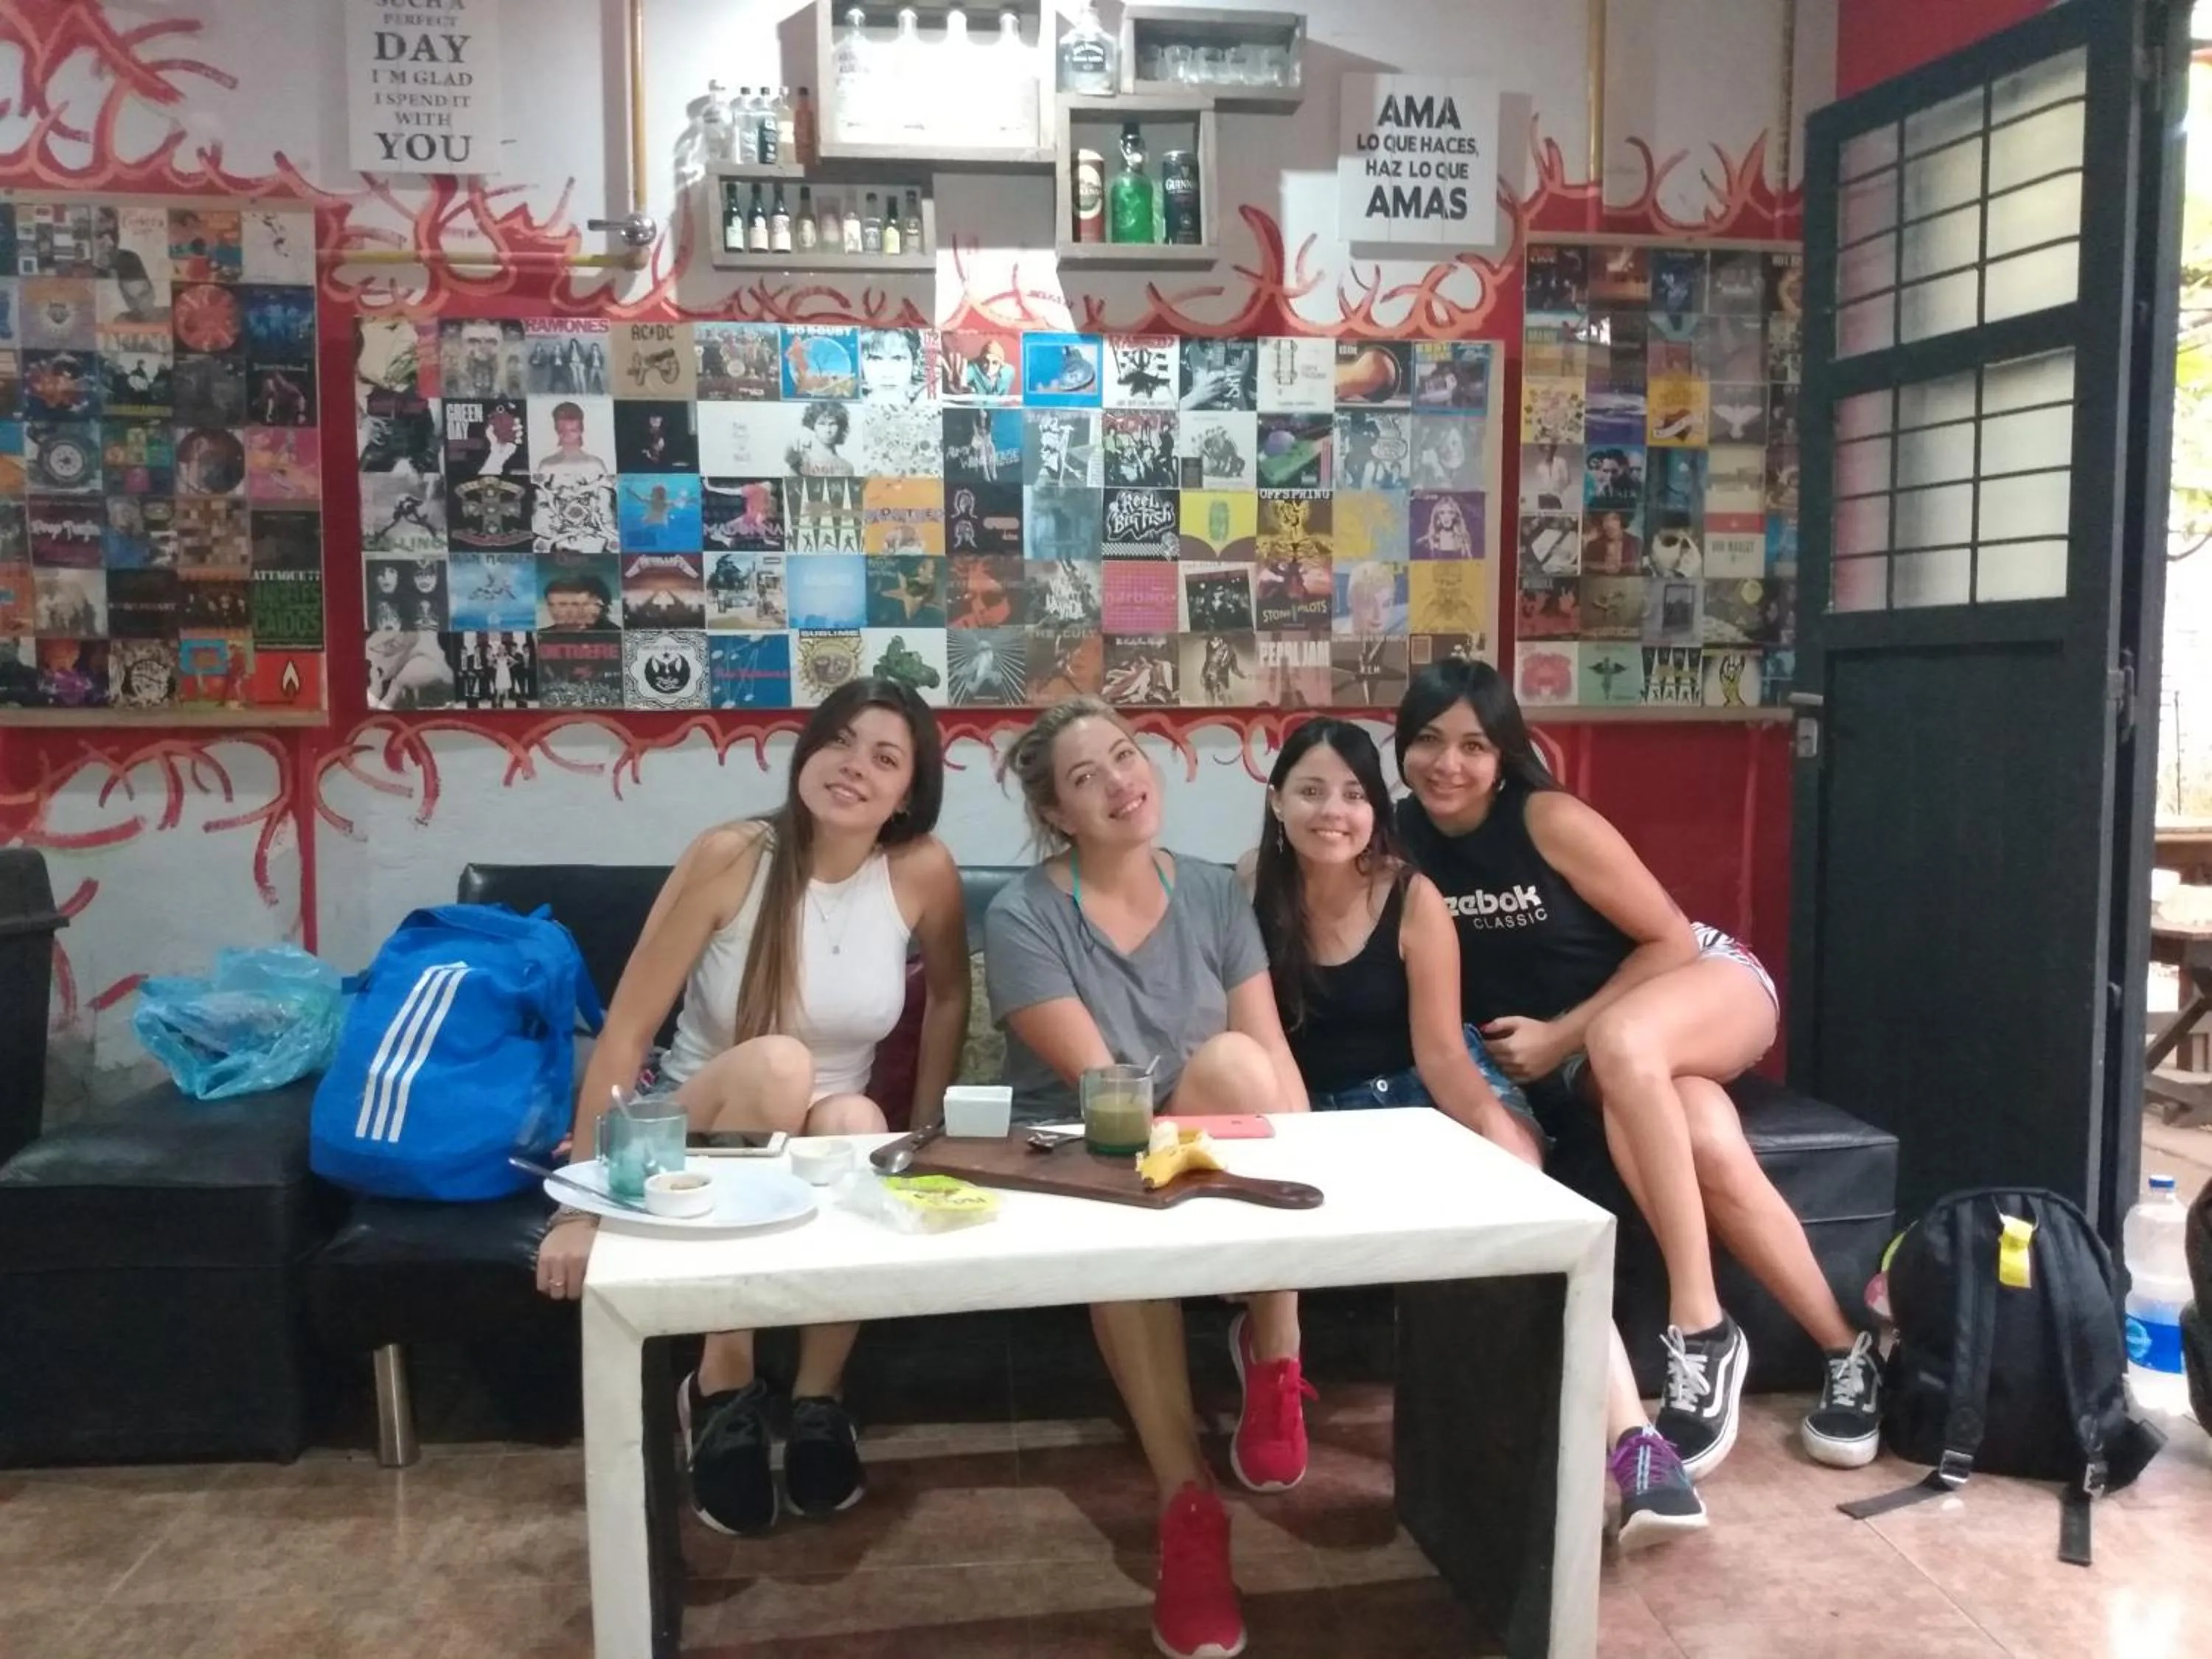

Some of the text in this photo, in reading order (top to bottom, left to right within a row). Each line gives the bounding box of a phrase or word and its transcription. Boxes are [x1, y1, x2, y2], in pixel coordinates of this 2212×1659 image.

[383, 13, 459, 27] PERFECT
[373, 31, 472, 63] DAY
[414, 72, 473, 87] GLAD
[375, 93, 471, 108] I SPEND IT
[1377, 94, 1461, 130] AMA
[394, 112, 452, 126] WITH
[374, 132, 473, 162] YOU
[1357, 133, 1479, 157] LO QUE HACES,
[1366, 159, 1469, 180] HAZ LO QUE
[1366, 185, 1467, 220] AMAS
[1443, 885, 1543, 917] eebok
[1474, 908, 1548, 930] CLASSIC
